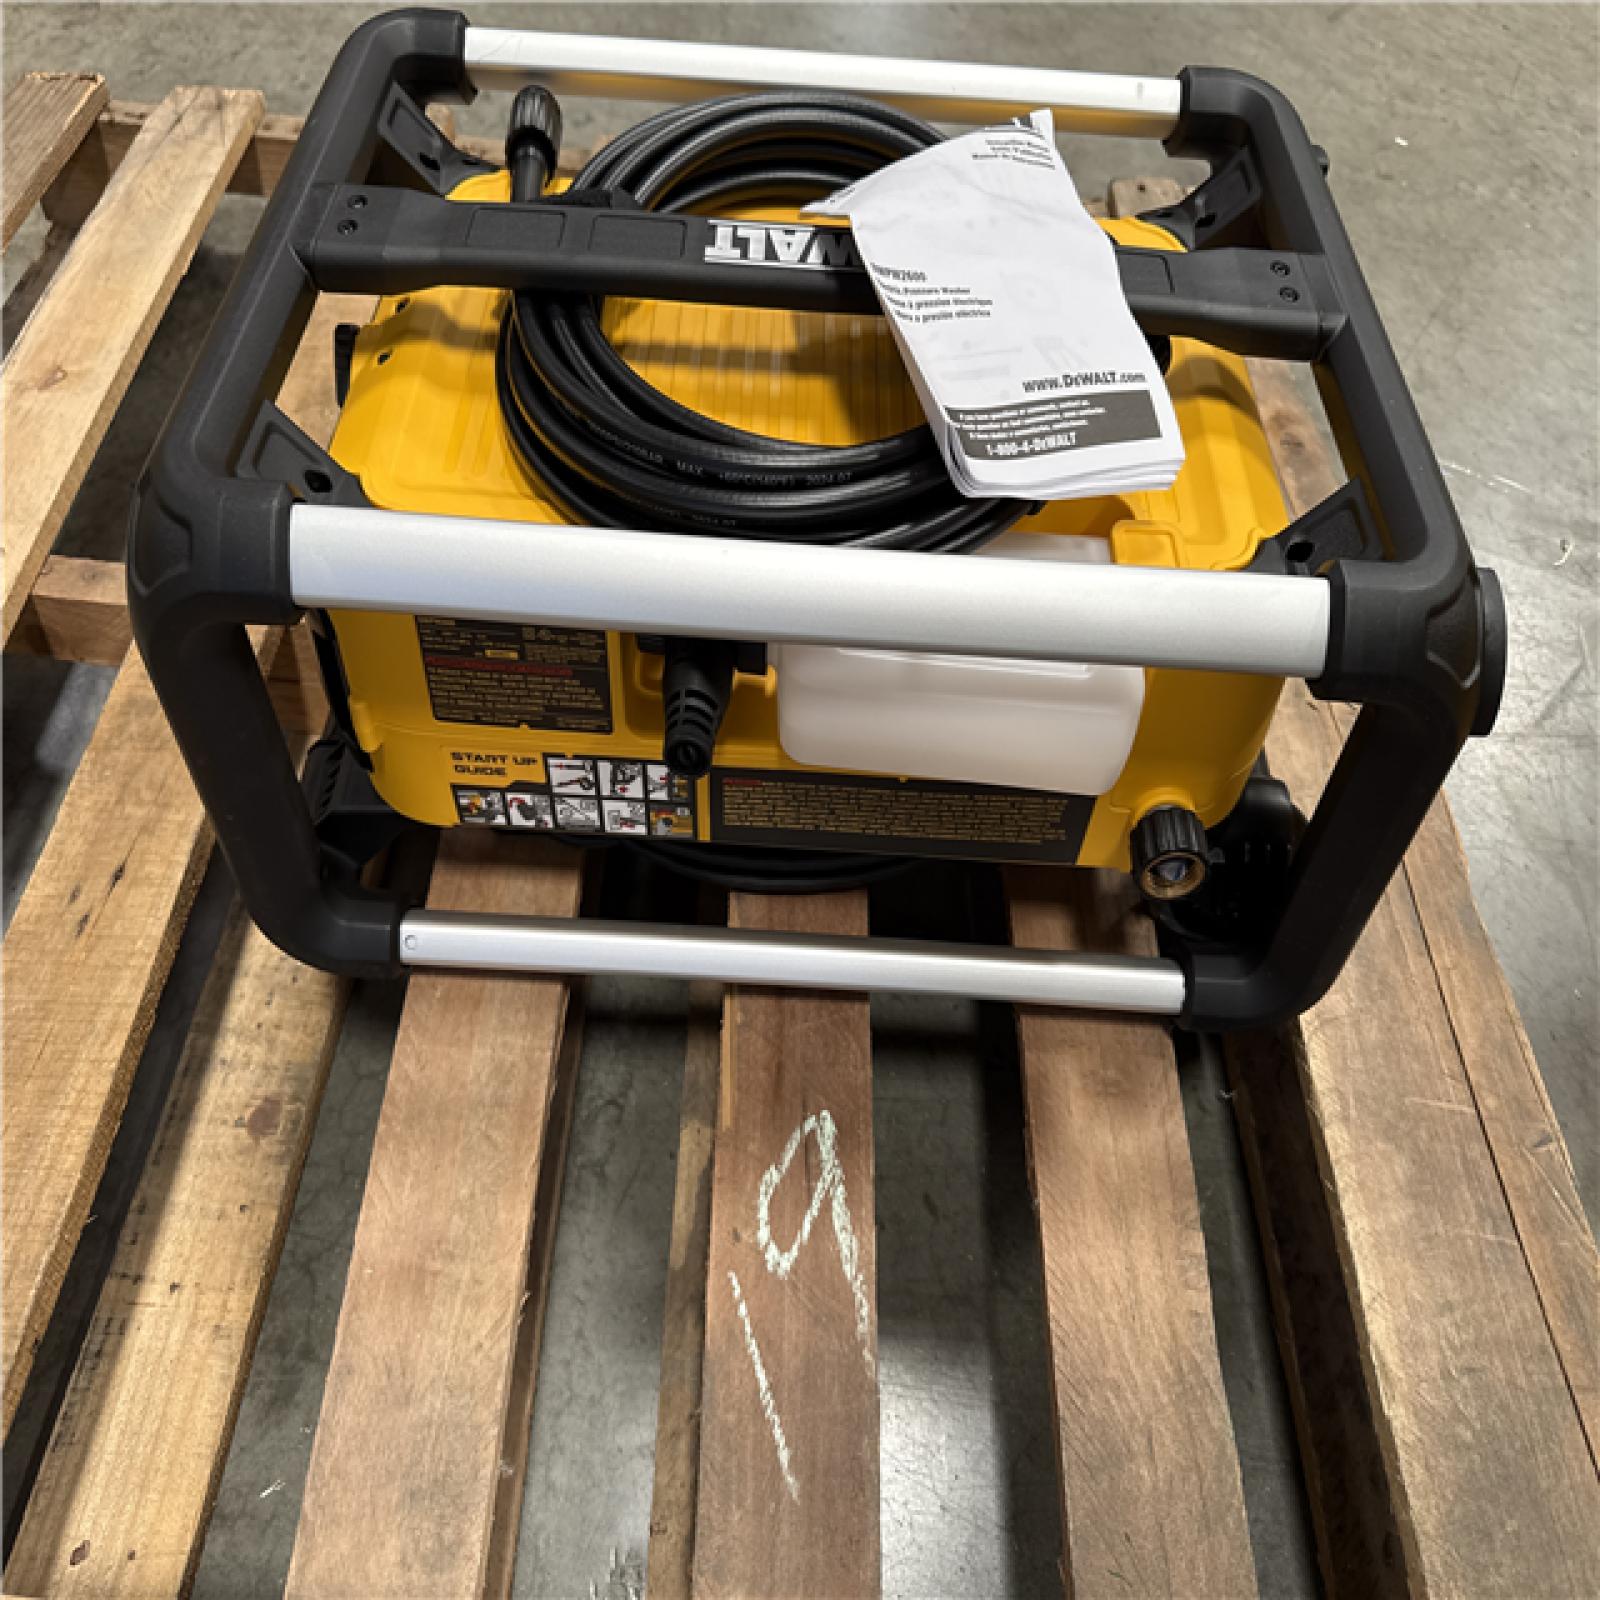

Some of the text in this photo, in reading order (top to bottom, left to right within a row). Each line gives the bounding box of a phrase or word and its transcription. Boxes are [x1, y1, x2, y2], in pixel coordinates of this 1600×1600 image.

[704, 219, 868, 270] WALT
[449, 752, 538, 766] START UP
